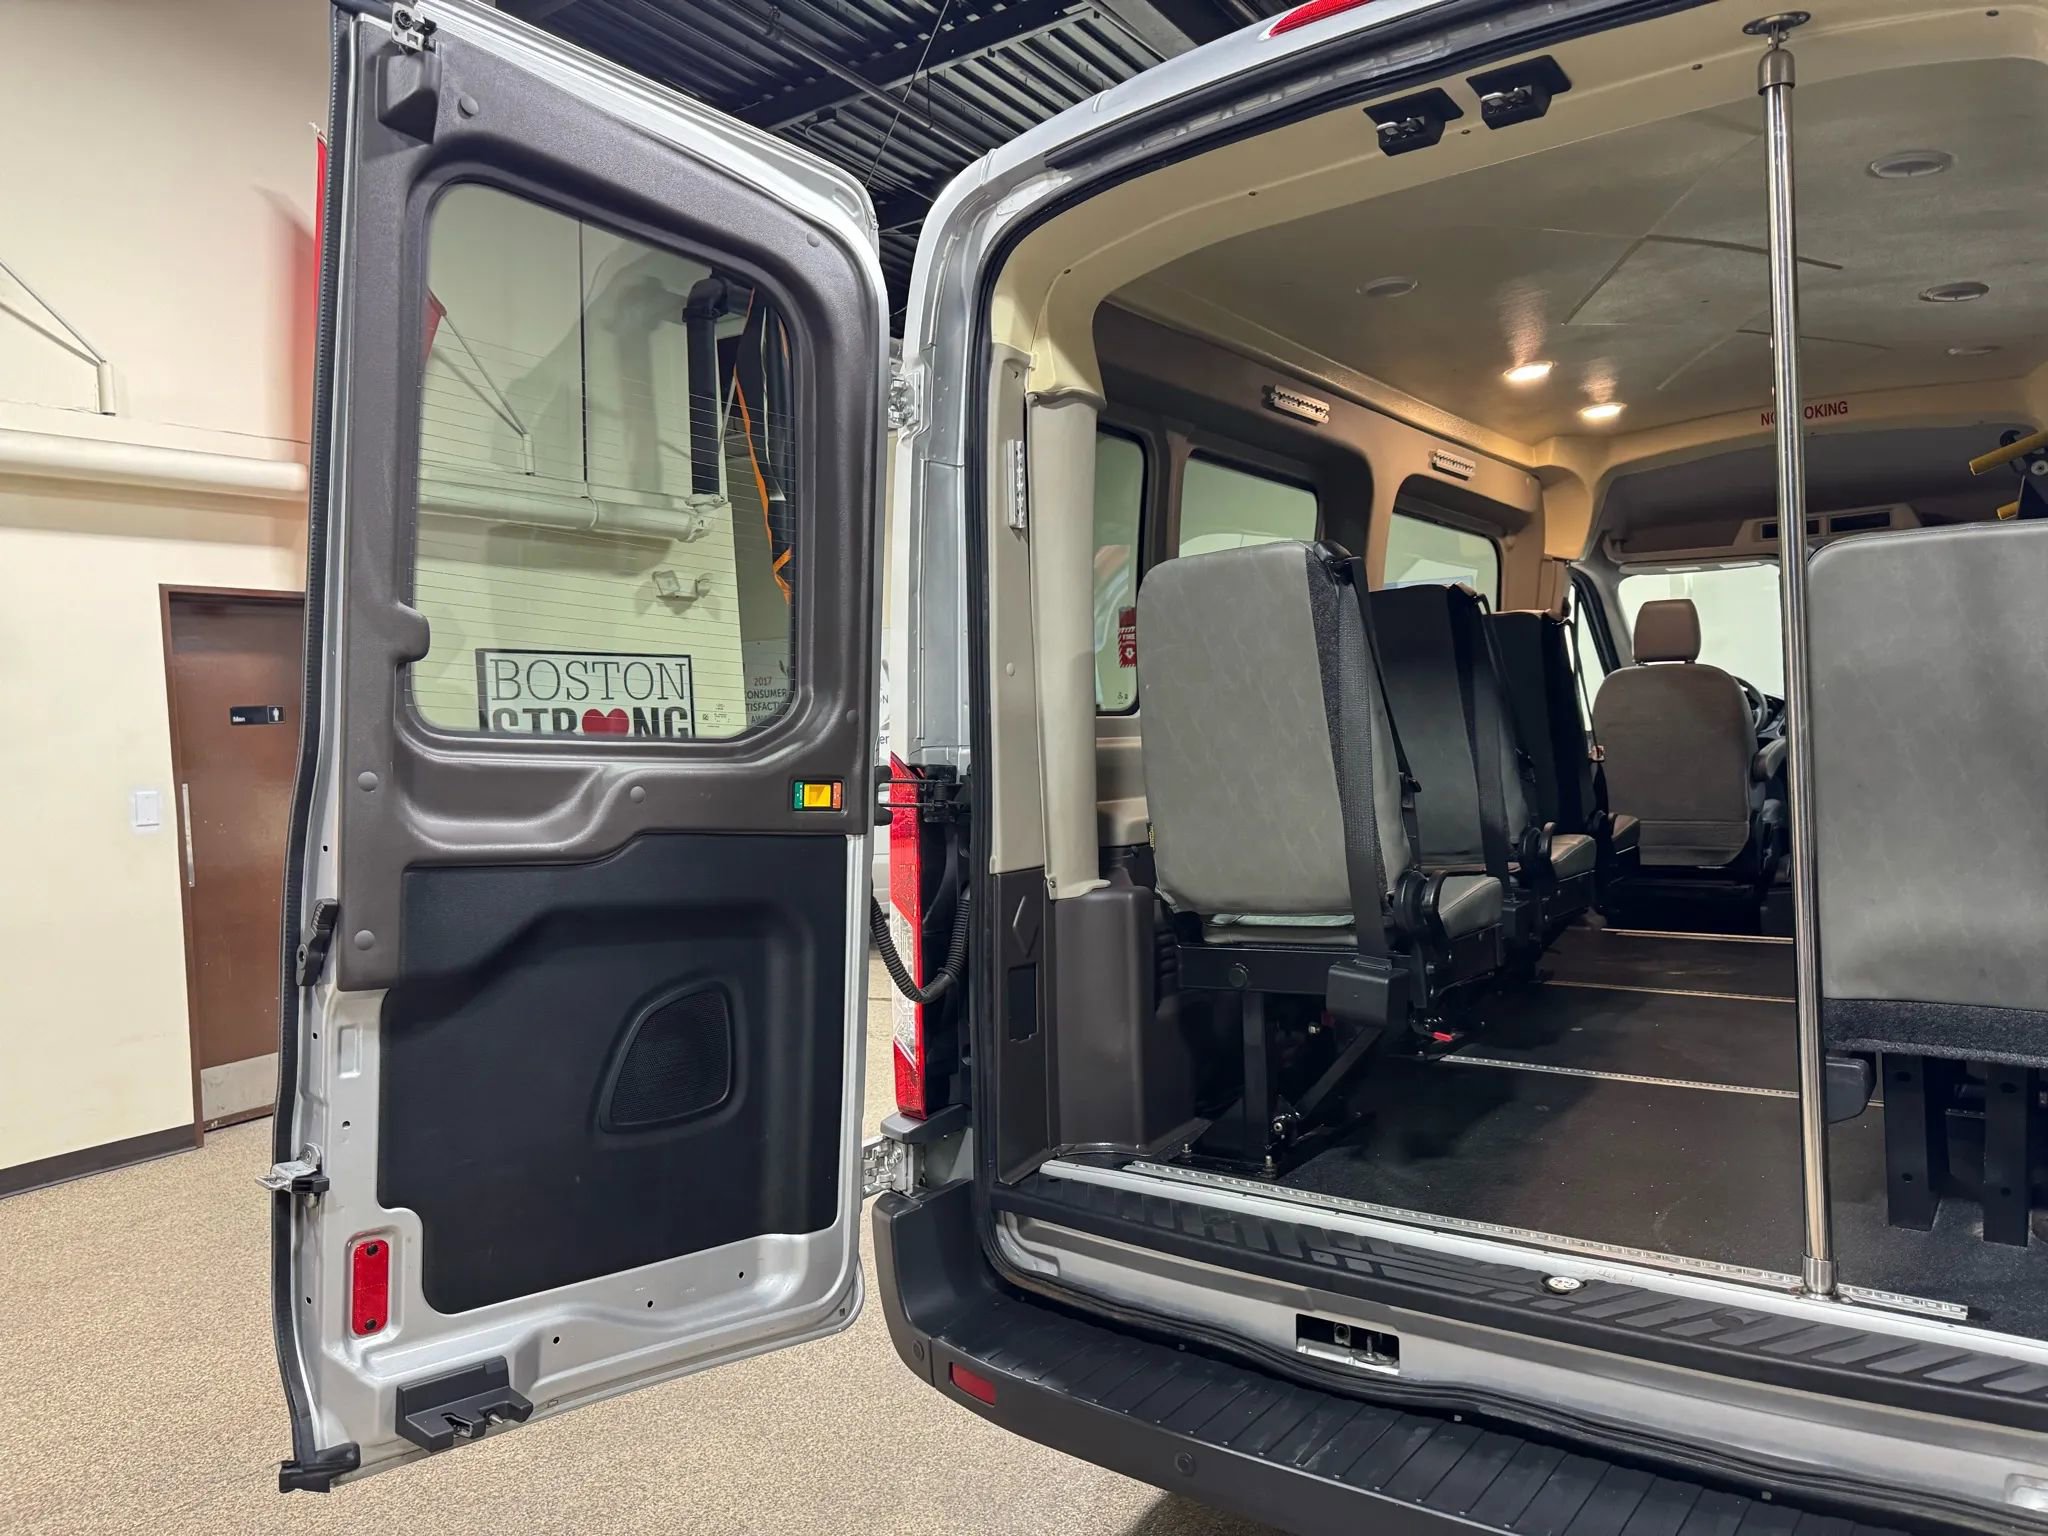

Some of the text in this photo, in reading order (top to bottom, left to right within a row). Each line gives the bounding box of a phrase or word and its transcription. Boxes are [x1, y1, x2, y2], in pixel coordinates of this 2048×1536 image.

[1804, 401, 1848, 419] OKING
[490, 659, 686, 701] BOSTON
[753, 676, 772, 686] 2017
[746, 688, 787, 700] ONSUMER
